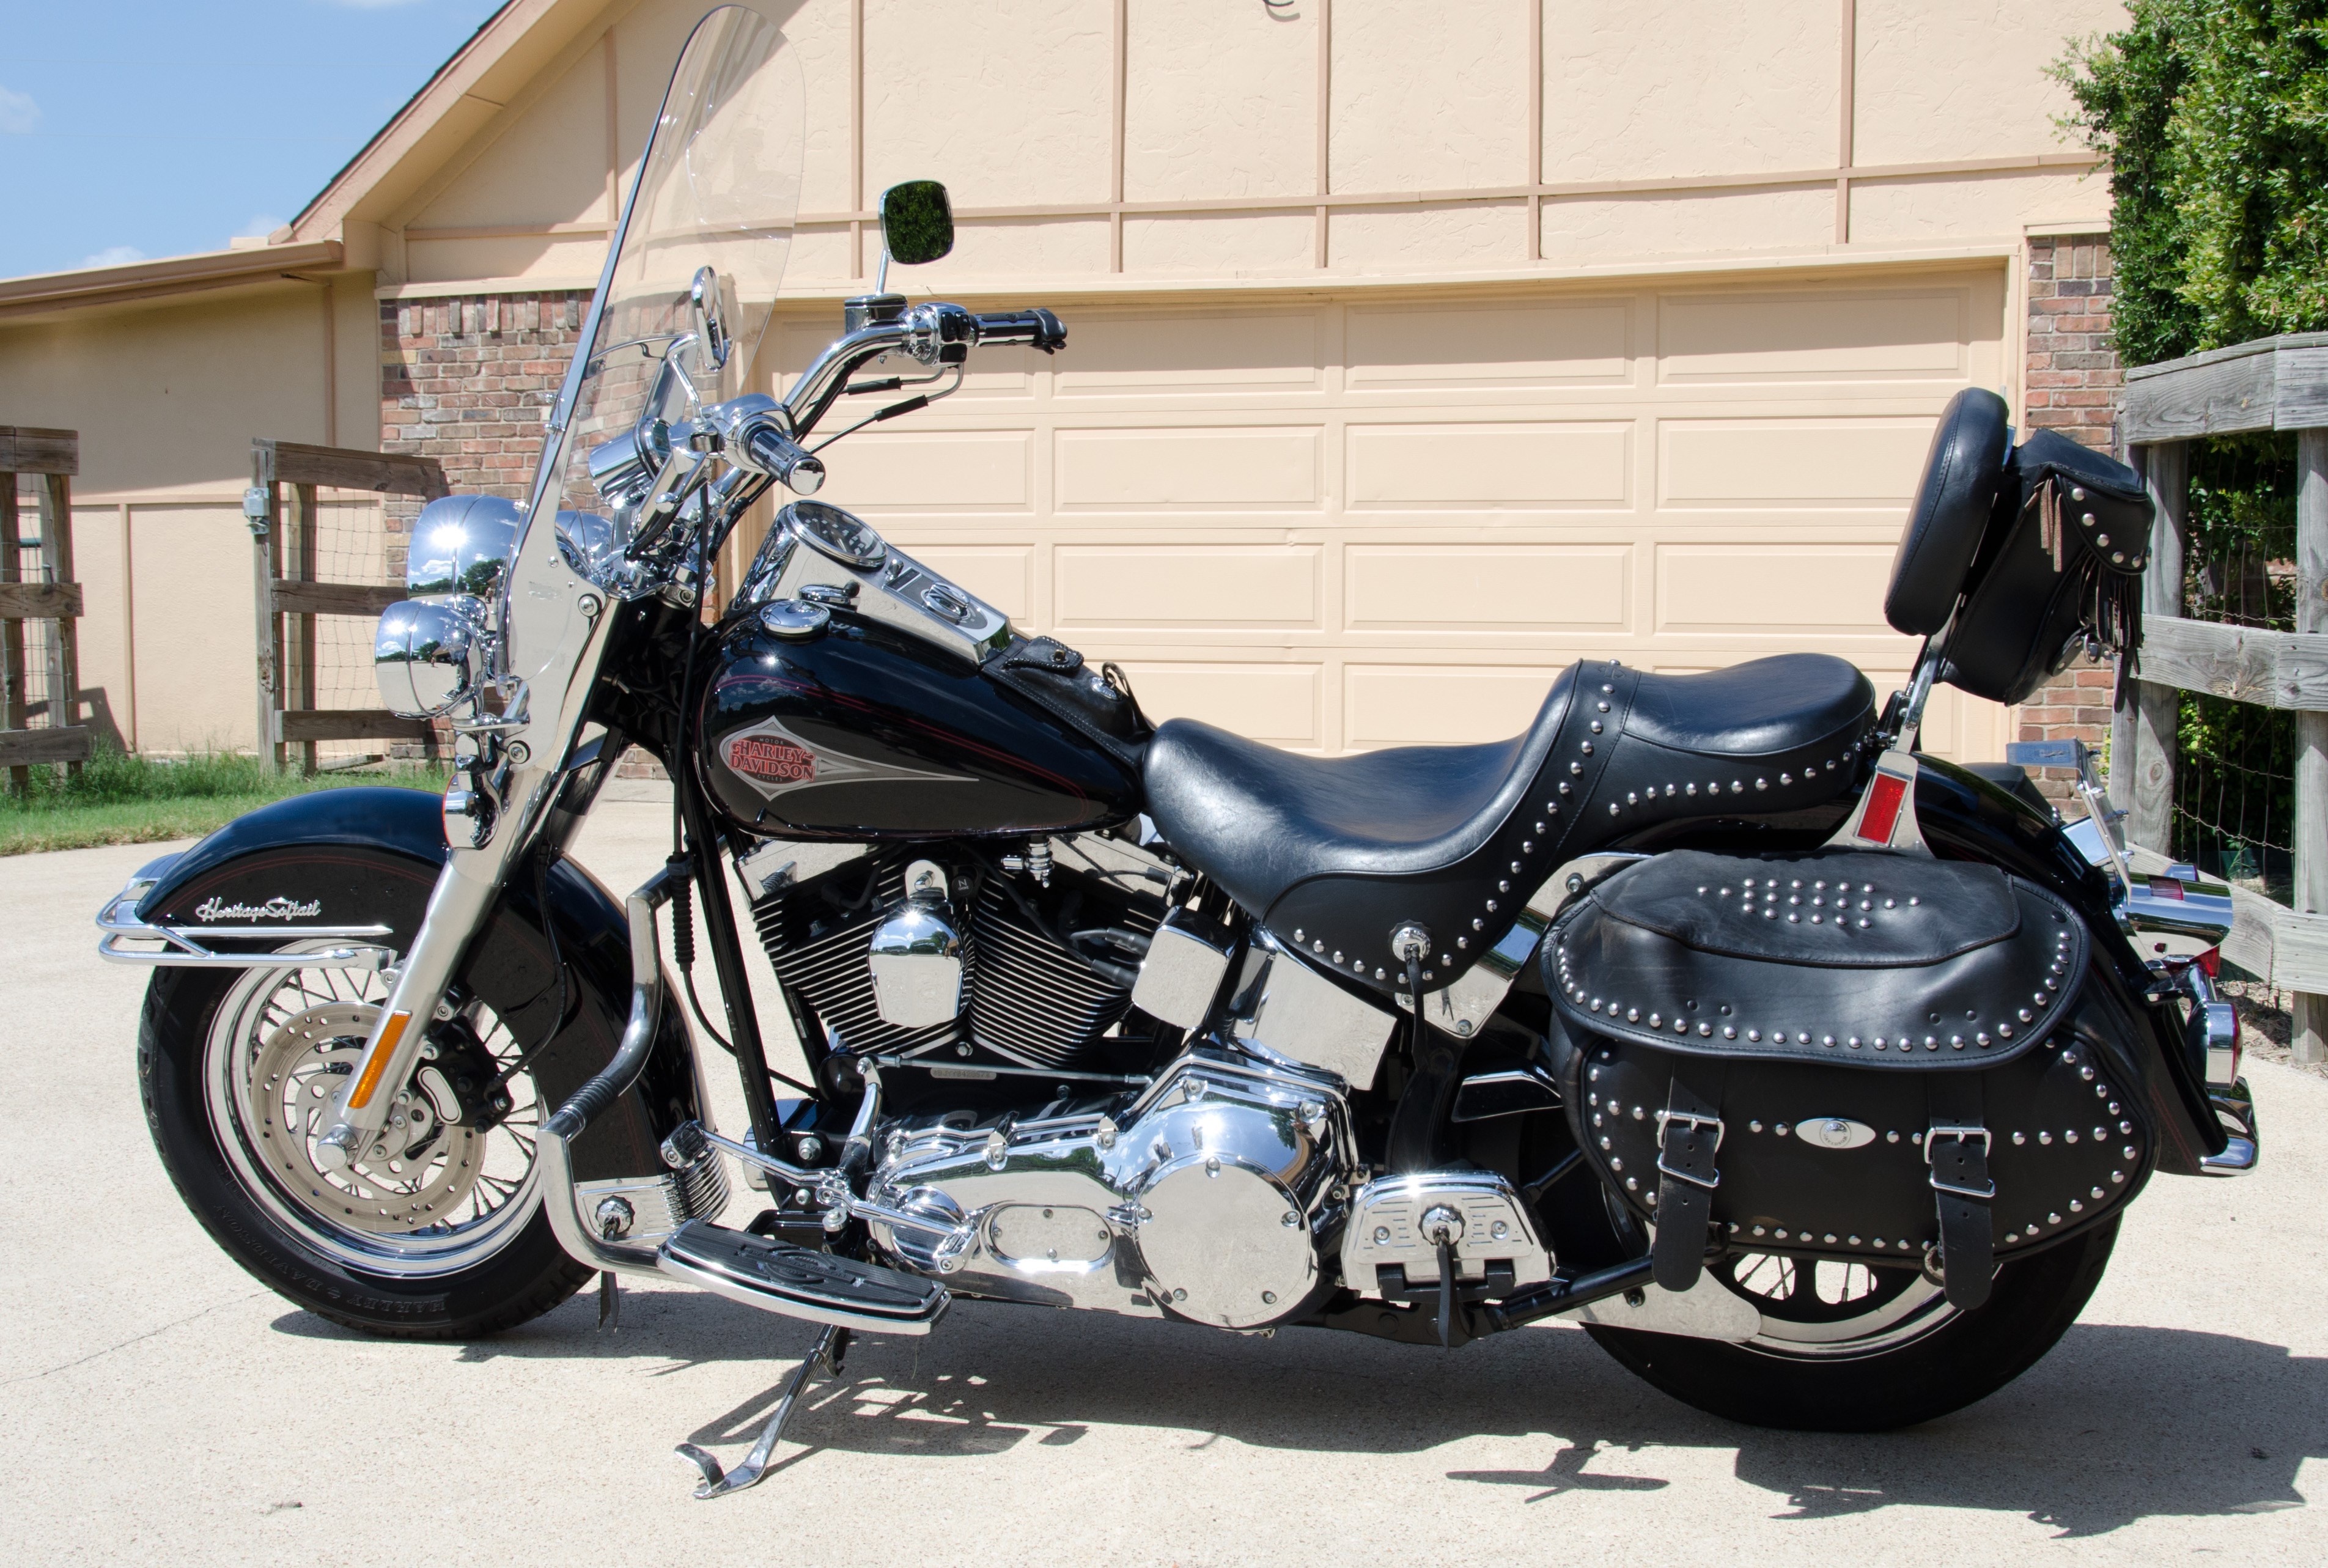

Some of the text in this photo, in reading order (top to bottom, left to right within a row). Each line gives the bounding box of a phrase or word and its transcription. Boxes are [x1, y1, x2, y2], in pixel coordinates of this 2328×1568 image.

[731, 739, 816, 763] HARLEY
[730, 753, 816, 782] DAVIDSON
[195, 896, 322, 922] Heritage Softail
[347, 1294, 446, 1313] HARLEY
